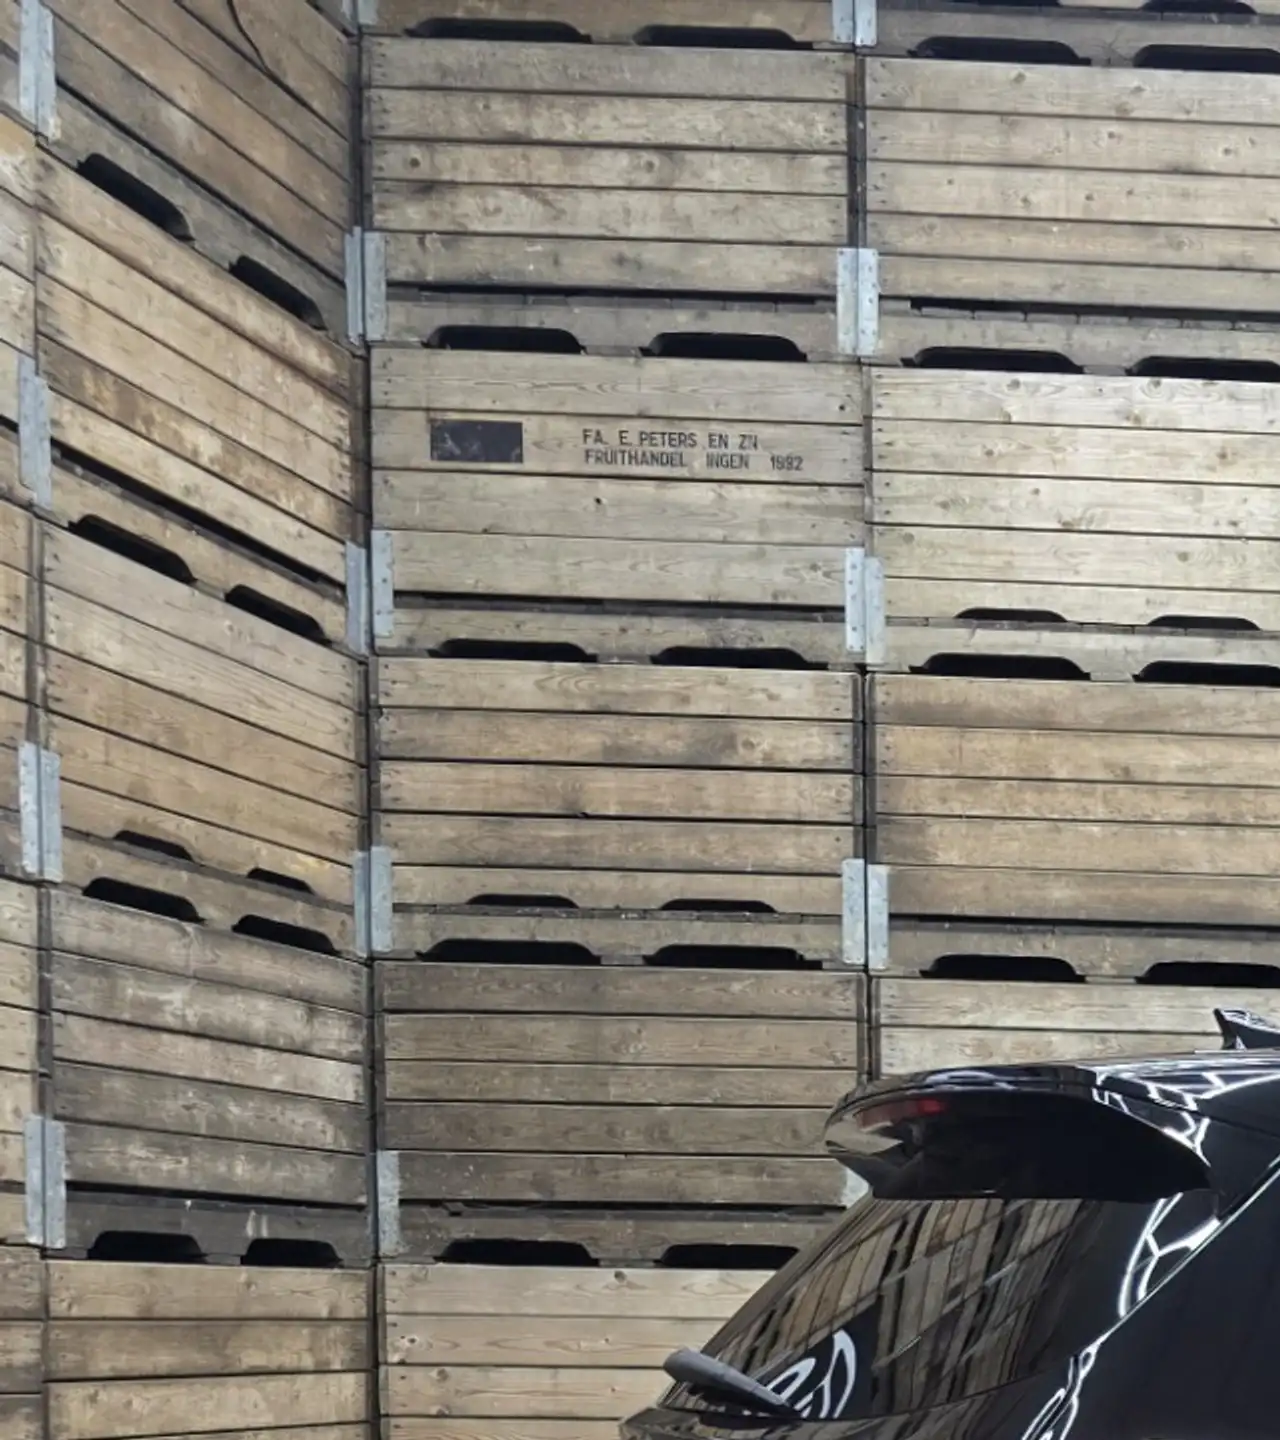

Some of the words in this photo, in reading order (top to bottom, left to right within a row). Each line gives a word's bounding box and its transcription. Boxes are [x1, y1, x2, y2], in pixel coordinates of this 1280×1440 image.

[638, 430, 699, 449] PETERS
[707, 432, 729, 450] EN
[584, 448, 688, 468] FRUITHANDEL
[705, 451, 751, 470] INGEN
